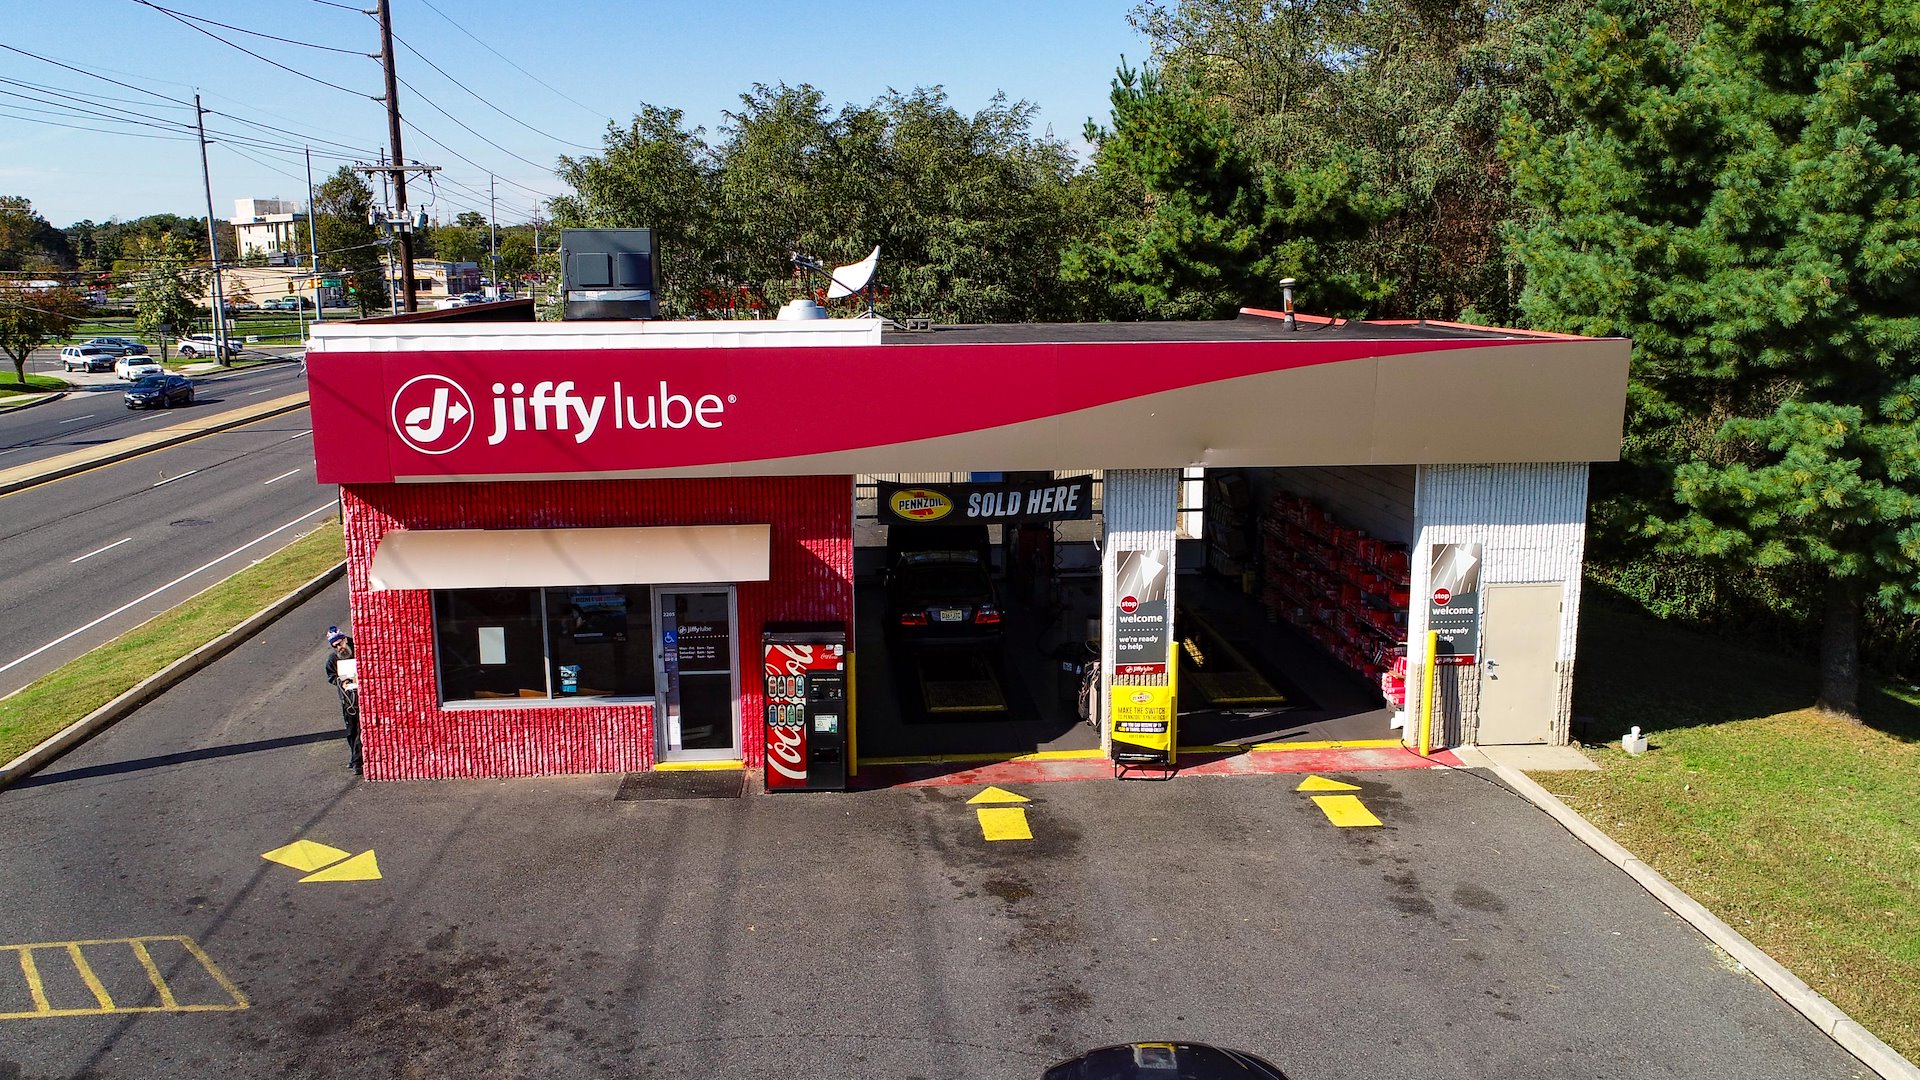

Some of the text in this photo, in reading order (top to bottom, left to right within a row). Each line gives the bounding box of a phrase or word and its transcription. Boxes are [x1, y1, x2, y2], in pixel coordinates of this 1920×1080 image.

[487, 381, 606, 446] jiffy
[967, 484, 1081, 518] SOLD HERE
[1432, 606, 1474, 615] welcome
[1119, 614, 1163, 623] welcome
[1450, 627, 1469, 635] ready
[1138, 635, 1158, 643] ready
[1127, 643, 1143, 651] help
